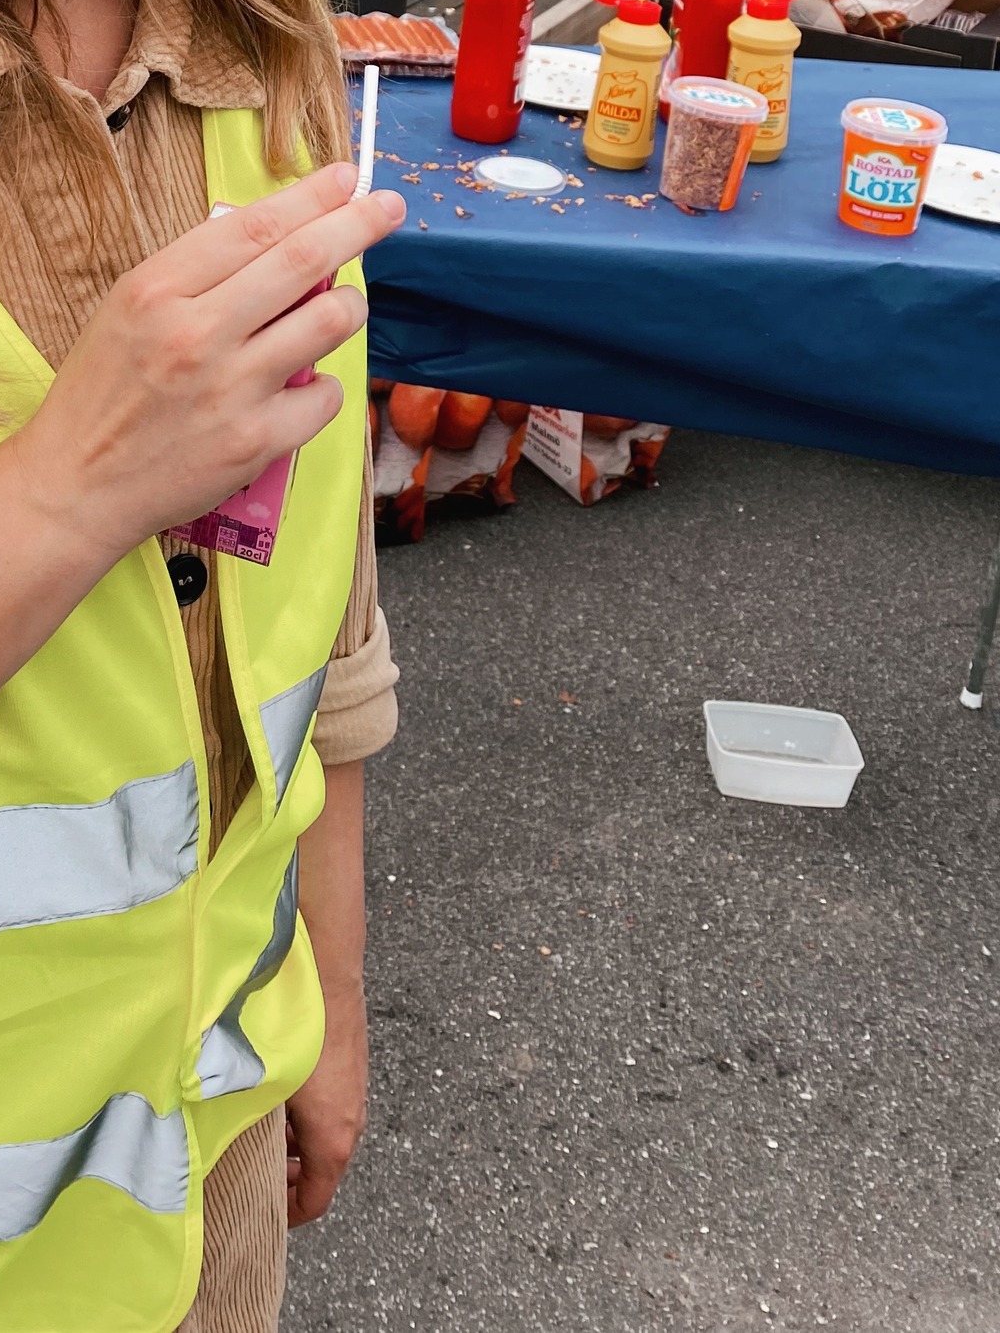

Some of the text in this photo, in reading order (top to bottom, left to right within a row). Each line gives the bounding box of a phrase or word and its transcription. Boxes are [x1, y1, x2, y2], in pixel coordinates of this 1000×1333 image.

[599, 103, 639, 120] MILDA
[855, 158, 914, 179] ROSTAD
[878, 156, 892, 165] ICA
[849, 169, 917, 204] LÖK
[531, 422, 560, 446] Malmö
[239, 547, 262, 561] 20 cl
